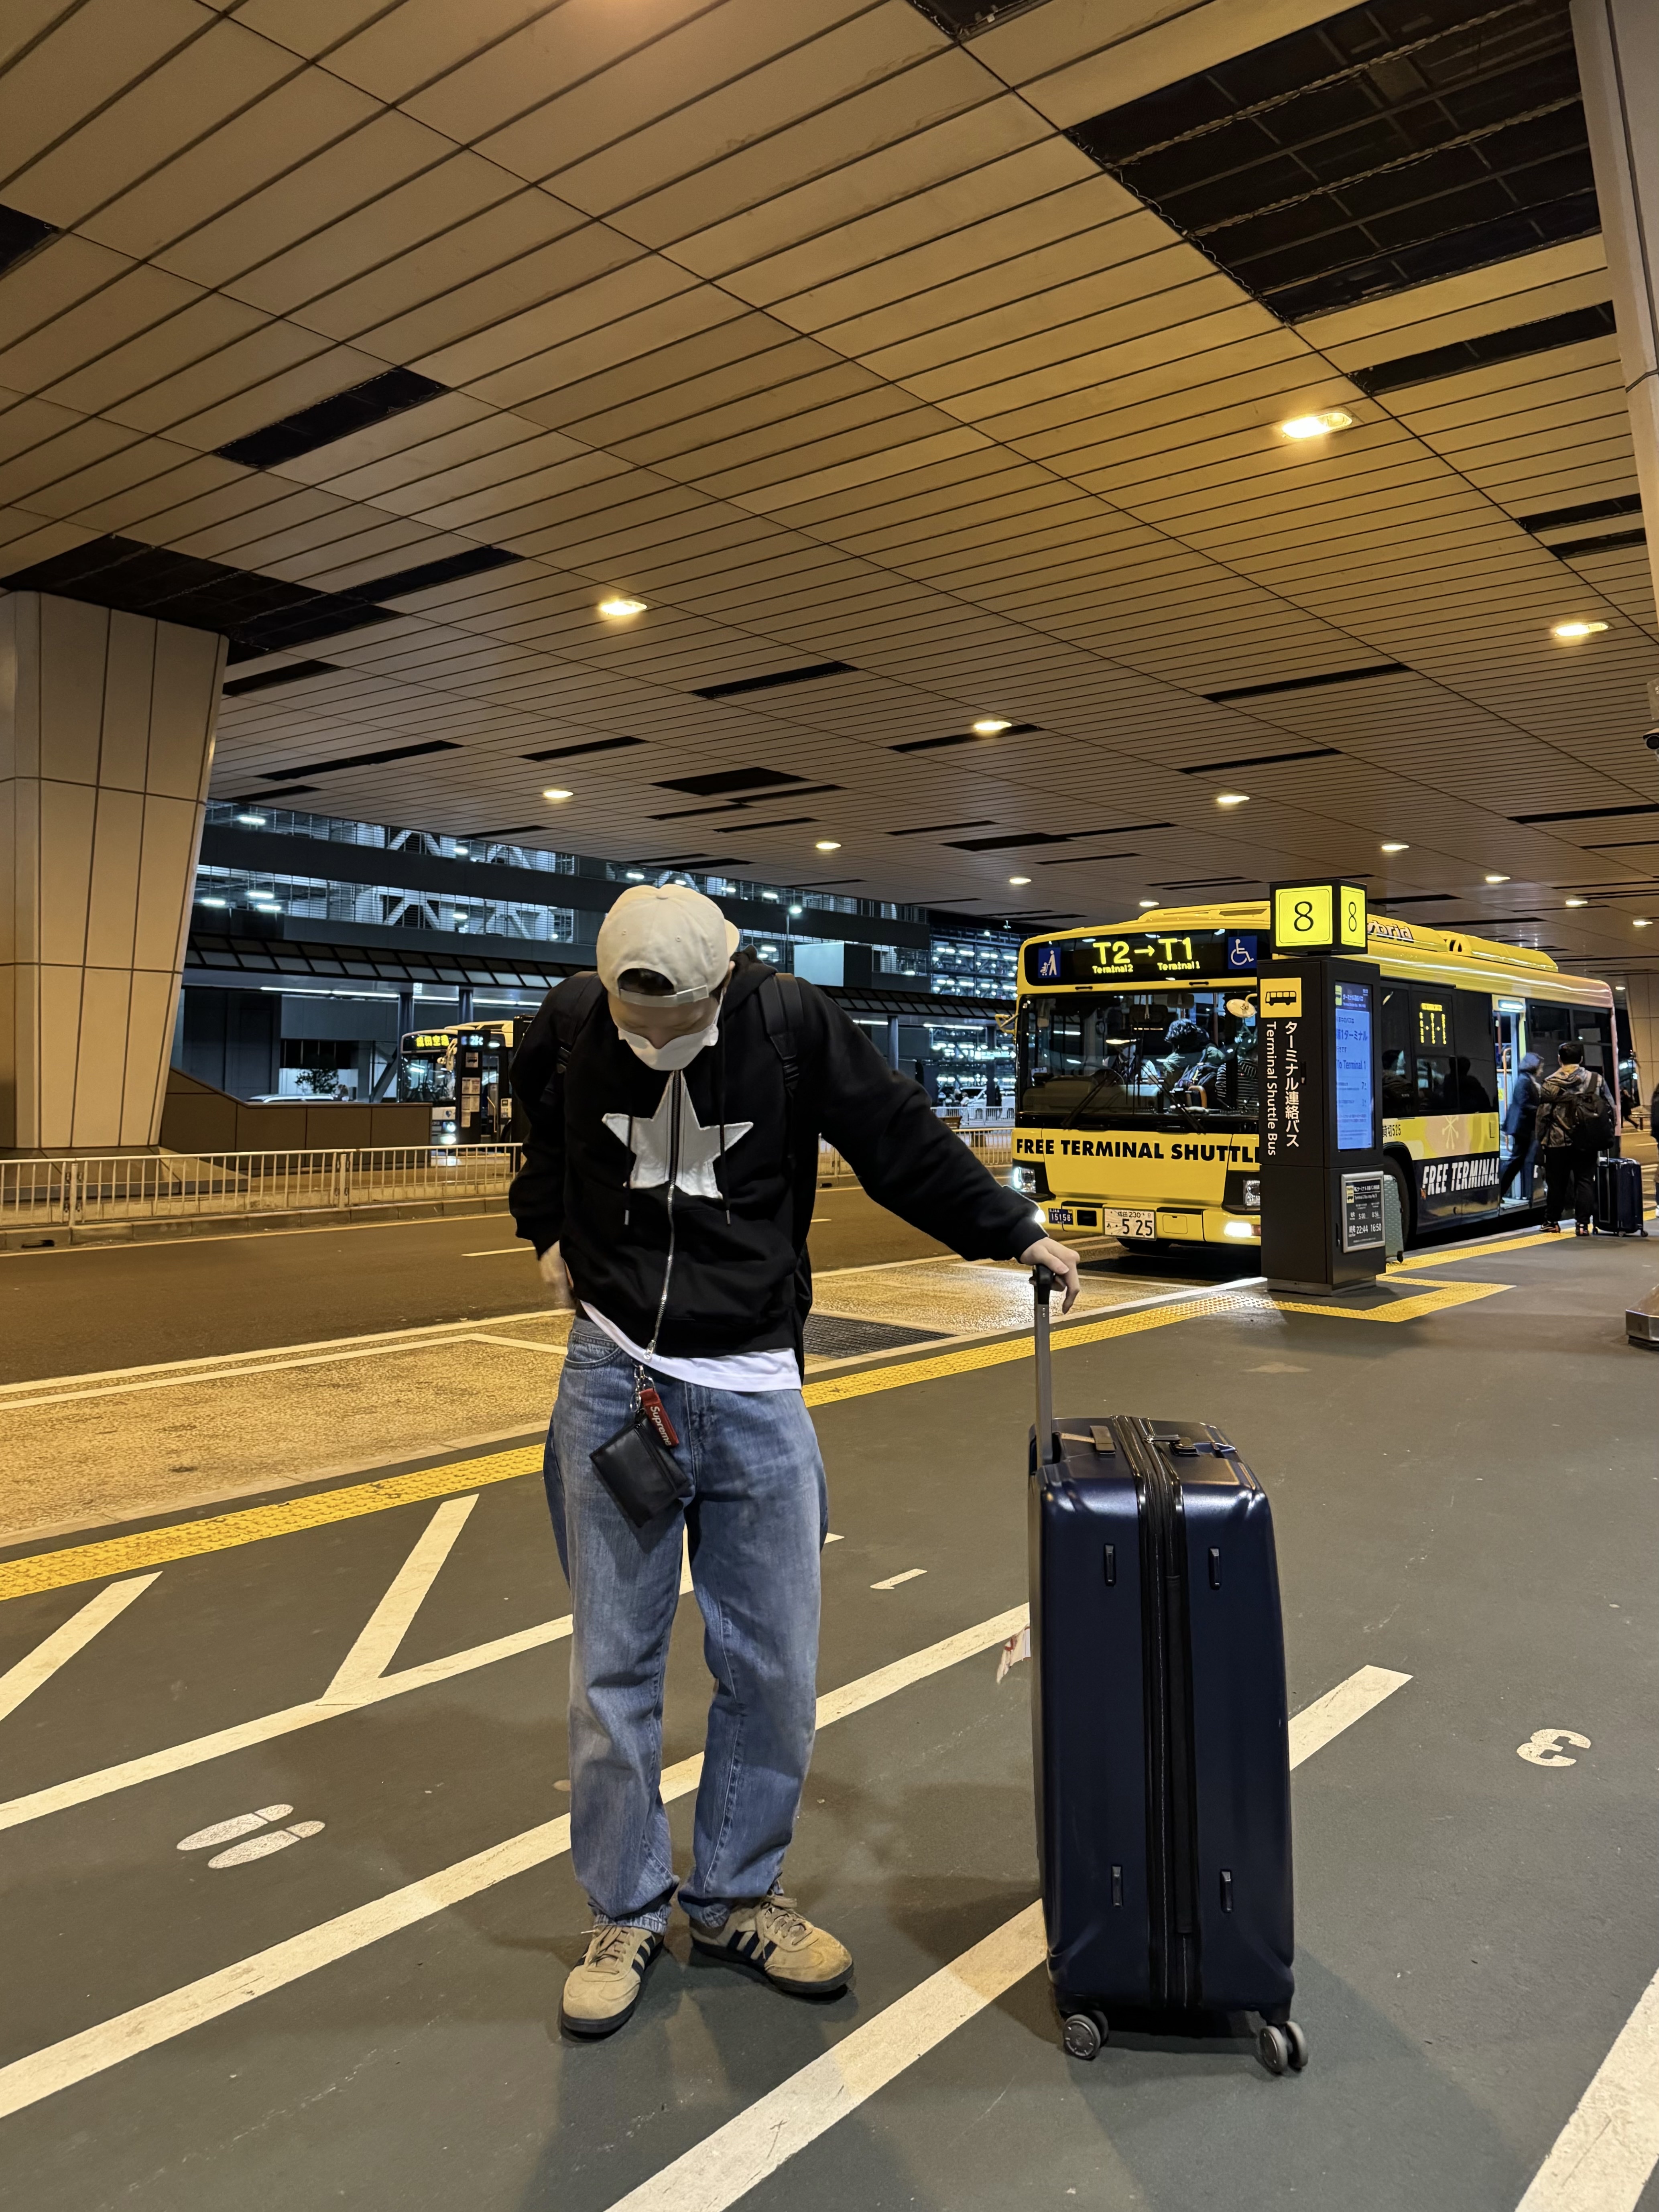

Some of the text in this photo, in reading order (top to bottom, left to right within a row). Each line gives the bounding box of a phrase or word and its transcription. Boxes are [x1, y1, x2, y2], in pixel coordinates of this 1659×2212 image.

[1294, 901, 1314, 931] 8
[1348, 901, 1357, 932] 8
[1267, 1021, 1278, 1155] Terminal Shuttle Bus
[1285, 1021, 1300, 1147] ターミナル連絡バス
[1017, 1139, 1055, 1155] FREE
[1061, 1140, 1164, 1159] TERMINAL
[1423, 1163, 1449, 1195] FREE
[1451, 1157, 1500, 1191] TERMINAL
[1051, 1213, 1071, 1222] 15158
[651, 1406, 672, 1446] Supreme
